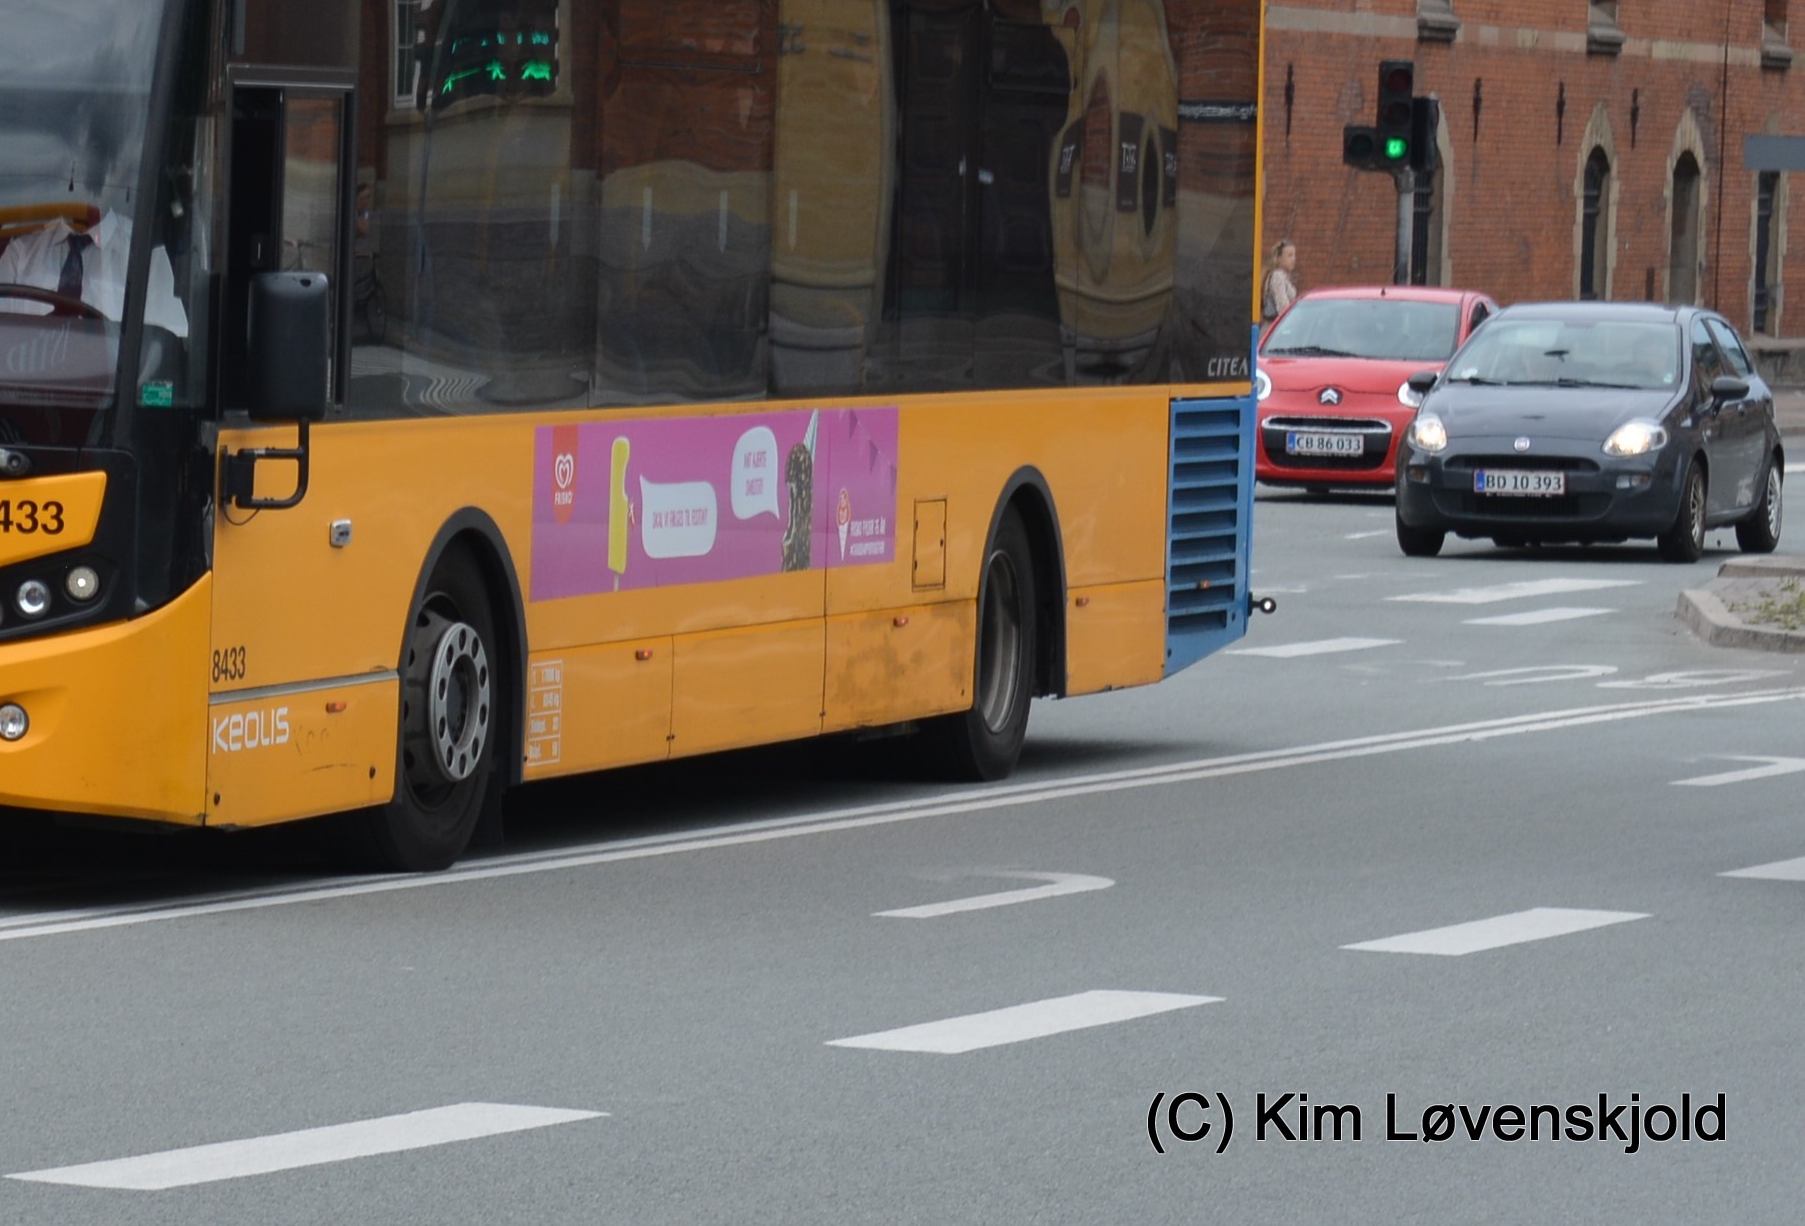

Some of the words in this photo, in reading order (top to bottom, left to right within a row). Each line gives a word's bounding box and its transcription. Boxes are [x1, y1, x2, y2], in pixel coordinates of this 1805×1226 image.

[1207, 357, 1249, 377] CITEA
[1317, 436, 1334, 450] 86
[1336, 437, 1361, 452] 033
[1512, 475, 1530, 491] 10
[1533, 476, 1562, 491] 393
[212, 645, 247, 683] 8433
